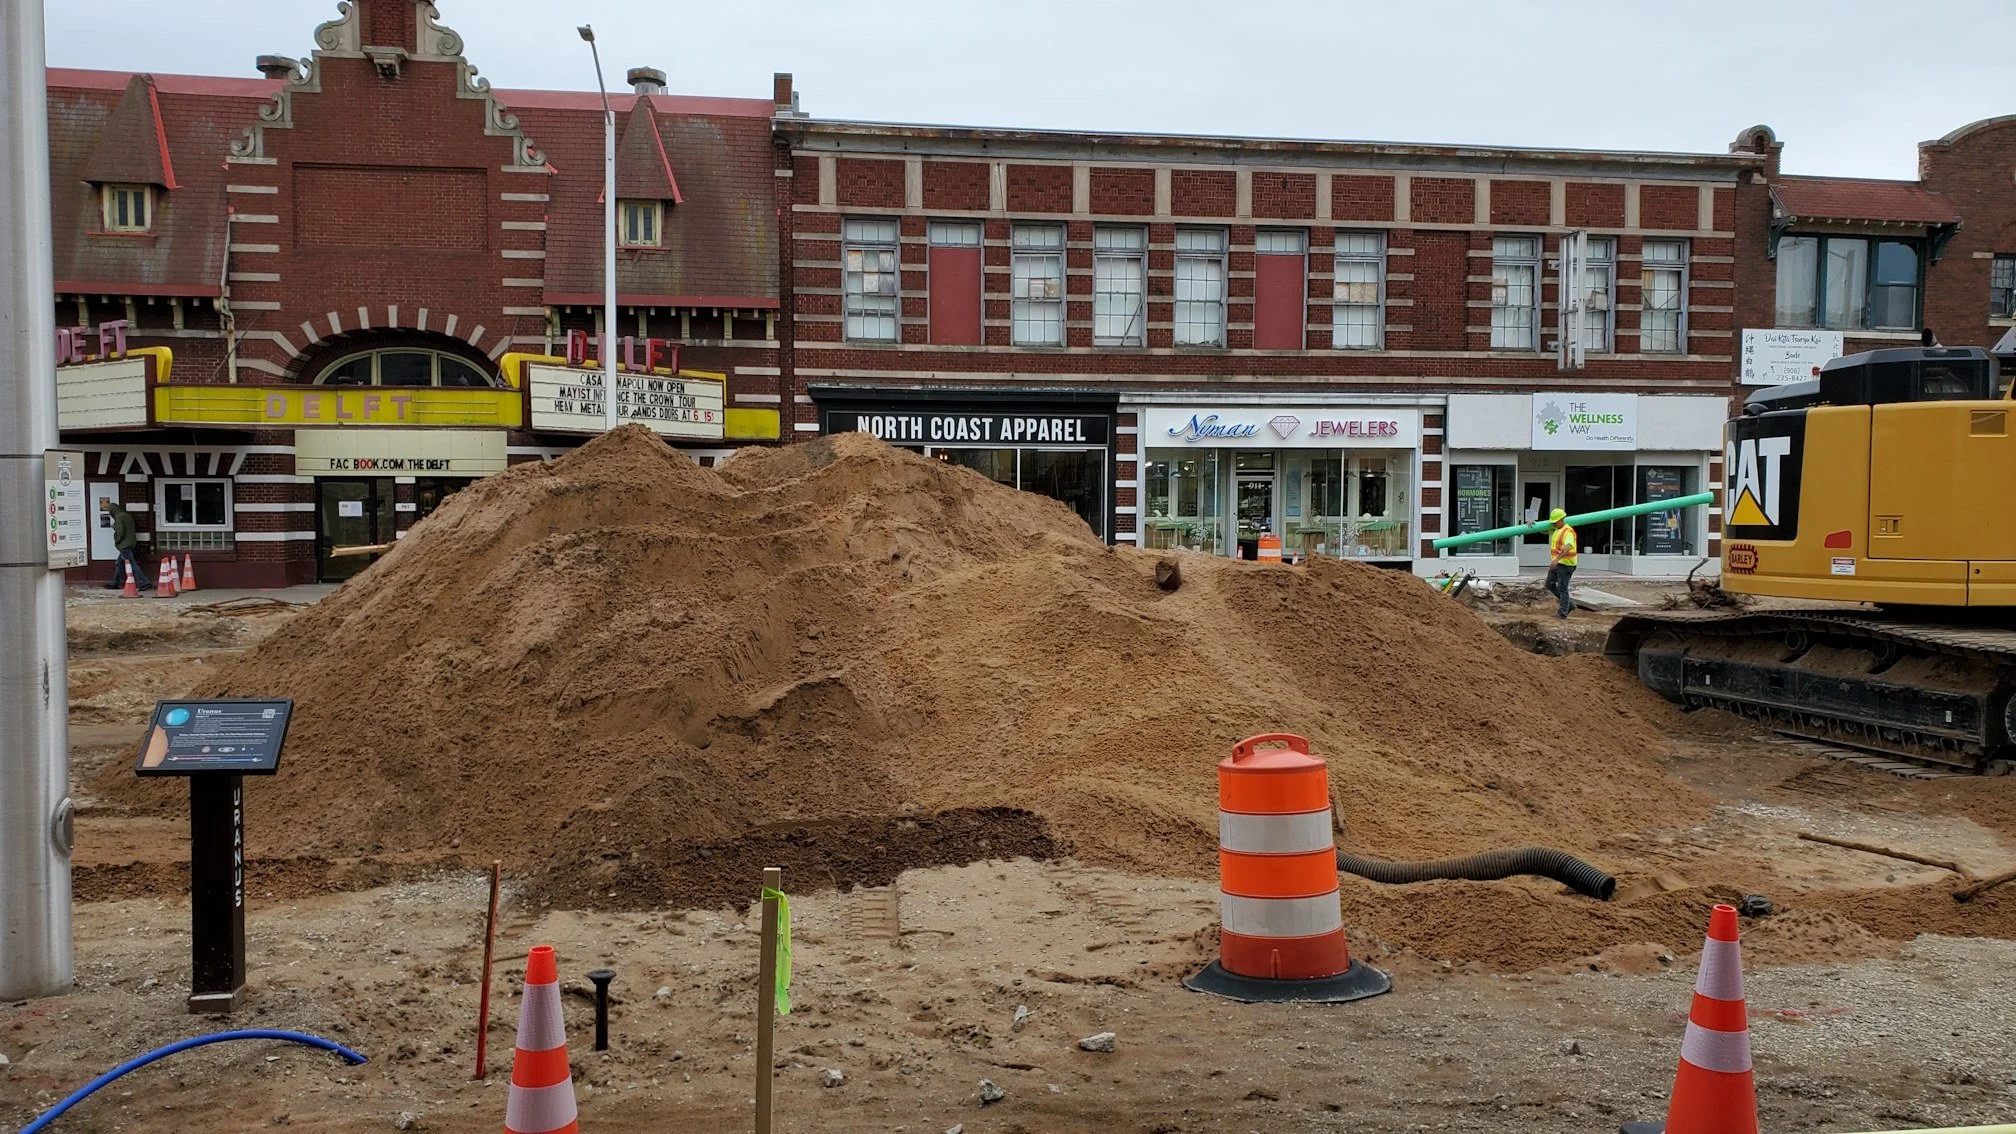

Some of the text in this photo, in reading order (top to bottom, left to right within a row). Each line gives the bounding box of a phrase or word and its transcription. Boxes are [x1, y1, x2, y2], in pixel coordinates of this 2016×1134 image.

[1783, 366, 1801, 375] (906)
[580, 374, 685, 394] CASA NAPOLI NOW OPEN
[266, 394, 411, 418] DELFT
[633, 392, 647, 404] THE
[649, 393, 674, 407] CROWN
[679, 395, 696, 408] TOUR
[1569, 402, 1587, 413] THE
[580, 402, 606, 415] METAL
[659, 407, 679, 421] DOORS
[682, 409, 691, 421] AT
[693, 410, 699, 421] 6
[1569, 414, 1624, 424] WELLNESS
[857, 415, 1086, 442] NORTH COAST APPAREL
[1167, 413, 1399, 442] Nyman JEWELERS
[1569, 425, 1591, 434] WAY
[408, 459, 424, 470] THE
[426, 459, 450, 470] DELFT
[1725, 436, 1791, 526] CAT
[1457, 489, 1491, 497] HORMONES
[1731, 552, 1753, 566] BARLEY
[233, 787, 242, 908] URANUS
